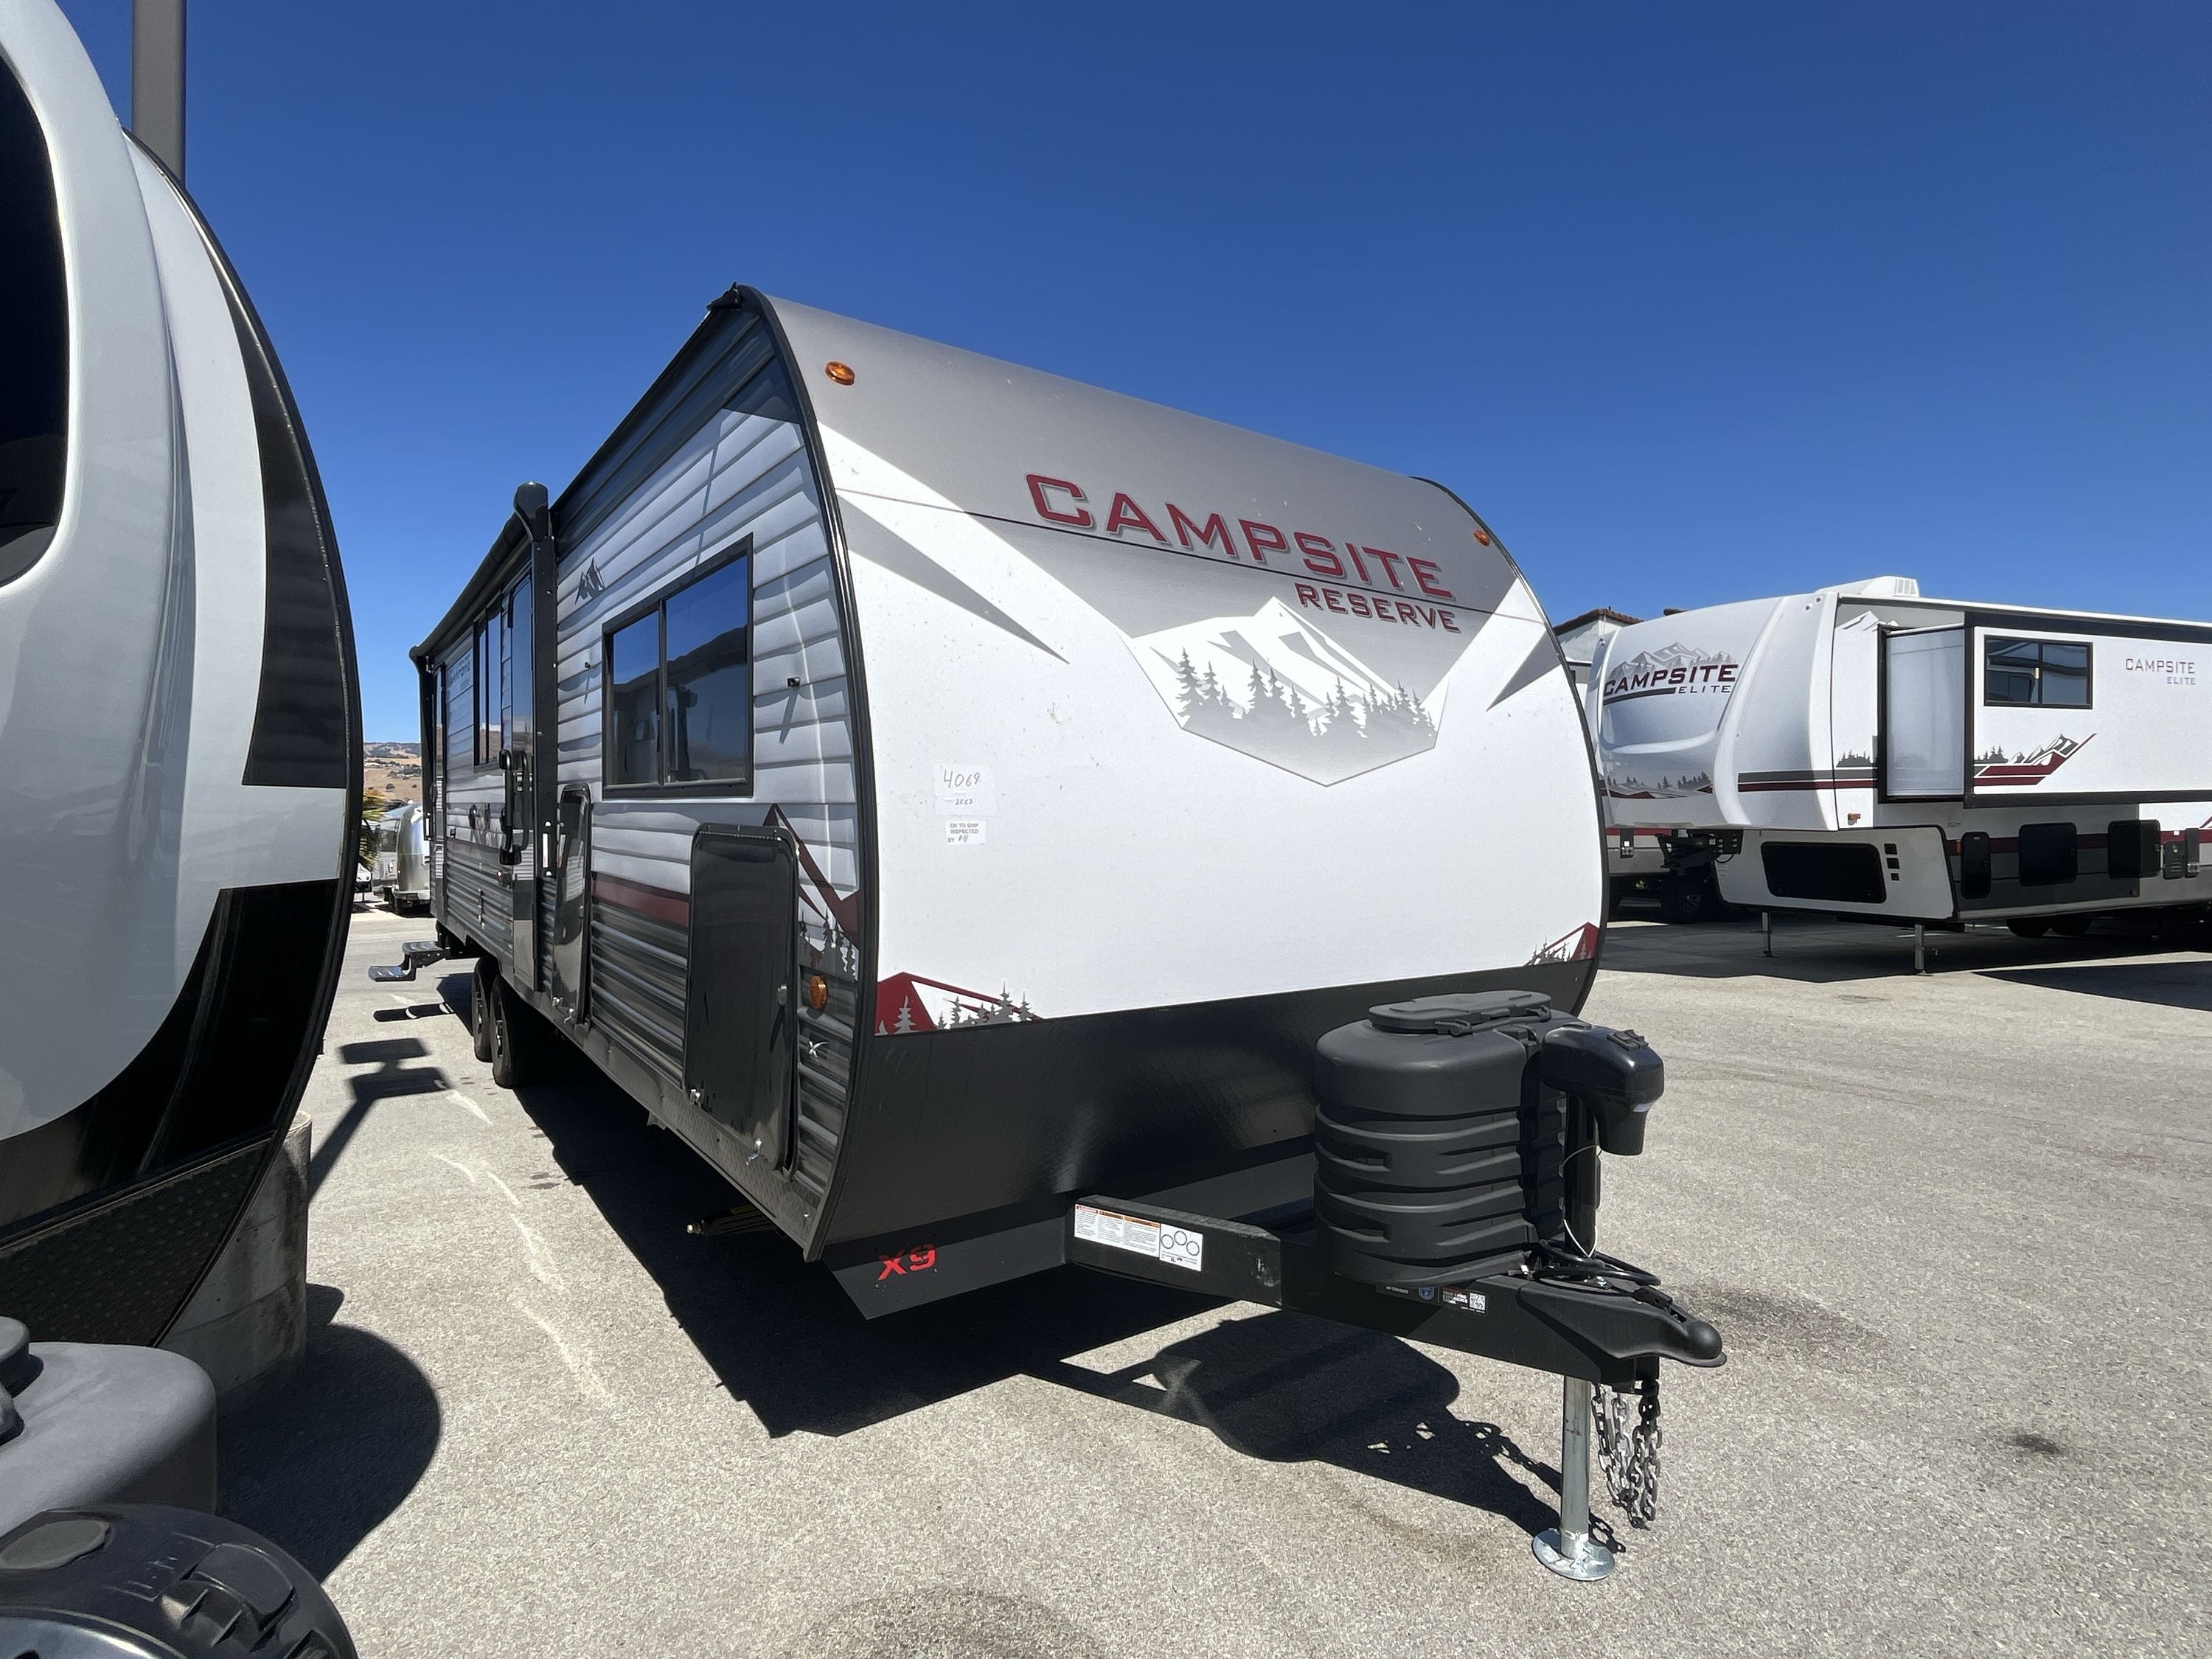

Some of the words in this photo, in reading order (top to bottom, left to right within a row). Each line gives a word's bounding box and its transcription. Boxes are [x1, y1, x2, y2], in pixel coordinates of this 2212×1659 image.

[1026, 473, 1455, 601] CAMPSITE
[1294, 582, 1461, 633] RESERVE
[2126, 658, 2194, 674] CAMPSITE
[1604, 664, 1738, 697] CAMPSITE
[1678, 685, 1731, 694] ELITE
[2166, 676, 2196, 685] ELITE
[943, 769, 981, 788] 4069
[877, 1244, 936, 1281] X9
